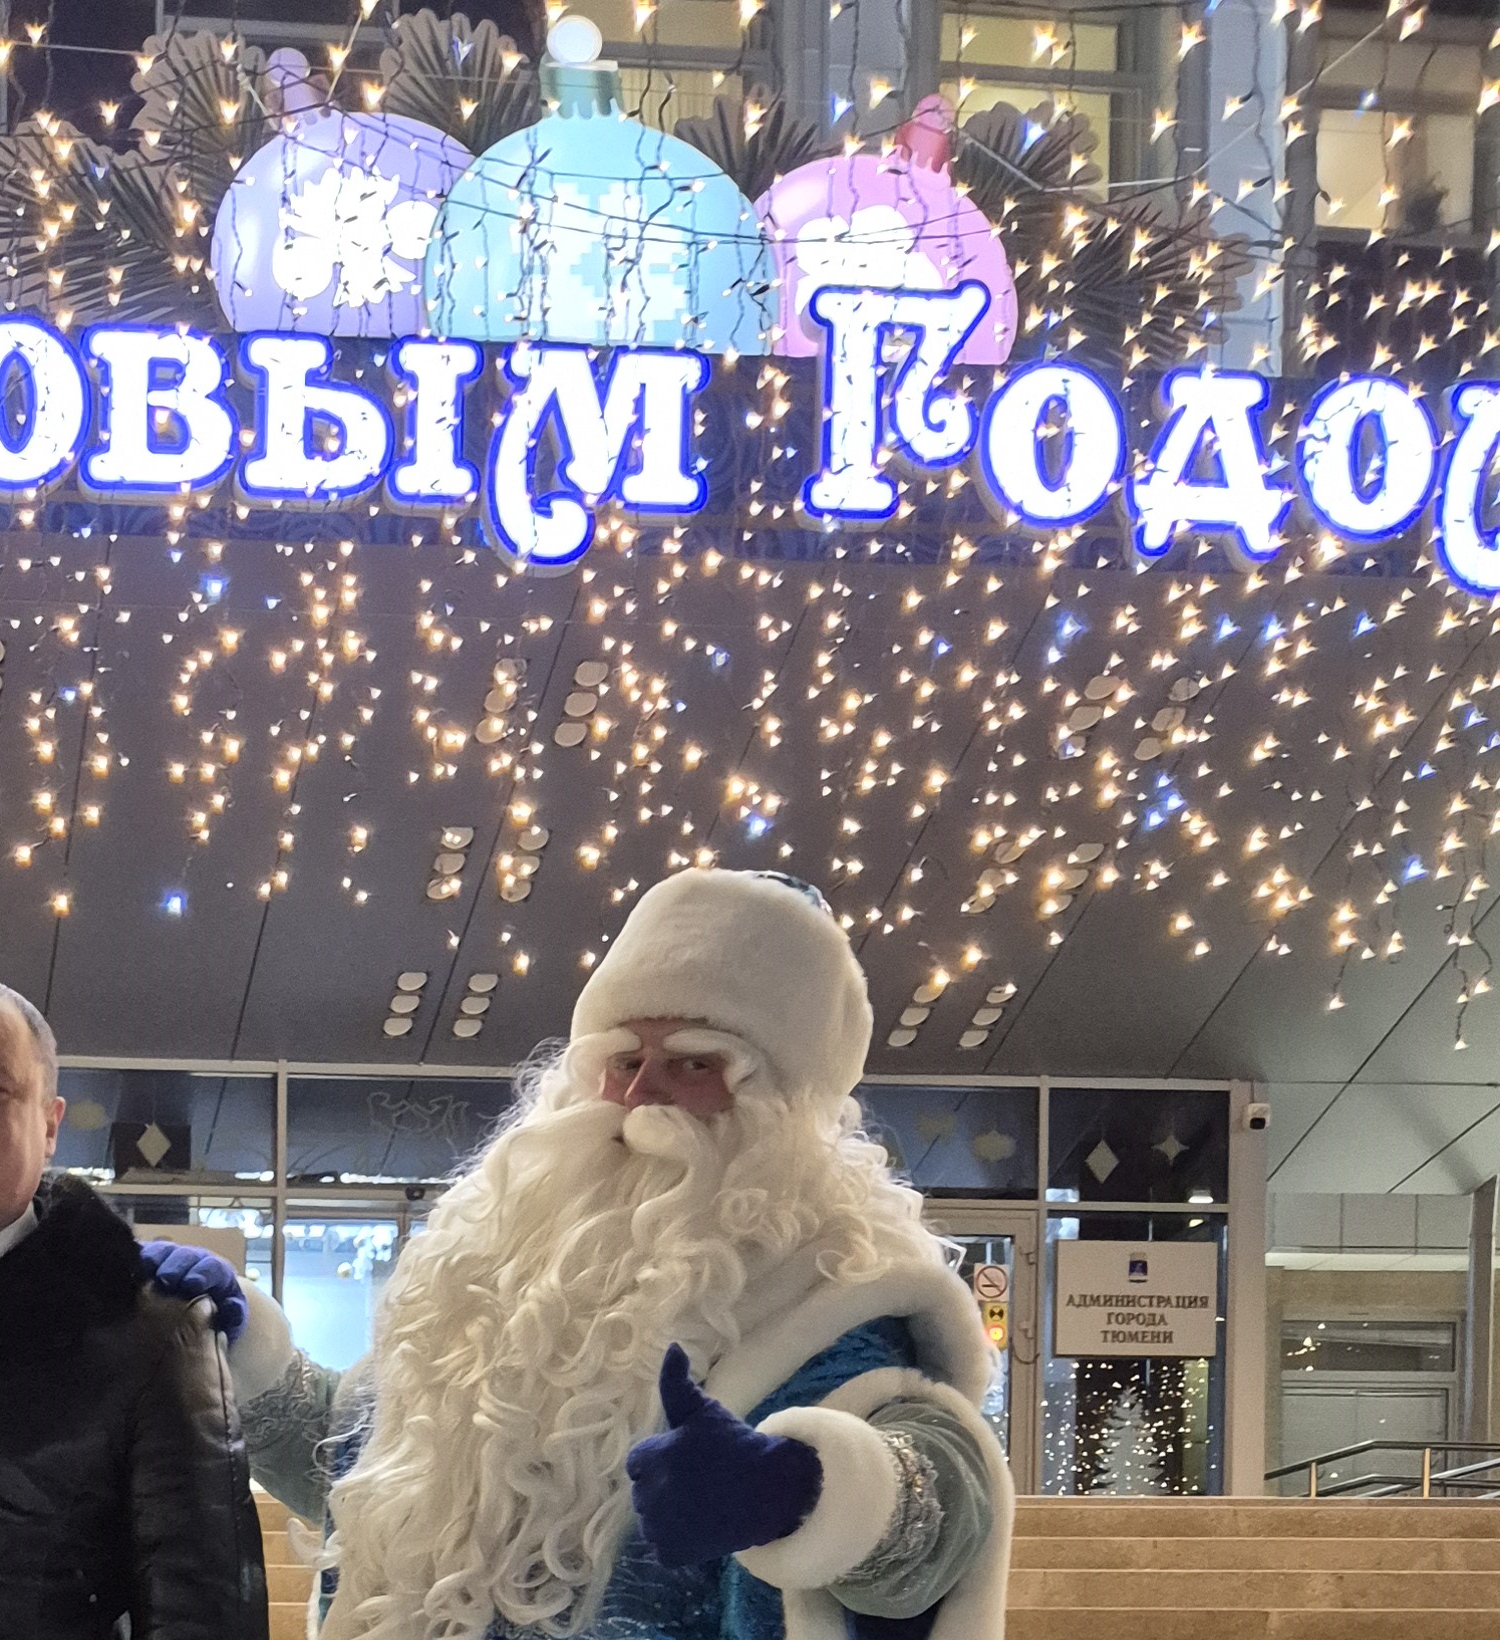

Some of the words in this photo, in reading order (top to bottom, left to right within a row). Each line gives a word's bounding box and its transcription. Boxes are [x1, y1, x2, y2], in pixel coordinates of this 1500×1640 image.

[803, 280, 1500, 598] Годо
[1065, 1294, 1209, 1310] АДМИНИСТРАЦИЯ
[1106, 1311, 1169, 1327] ГОРОДА
[1100, 1329, 1174, 1344] ТЮМЕНИ
